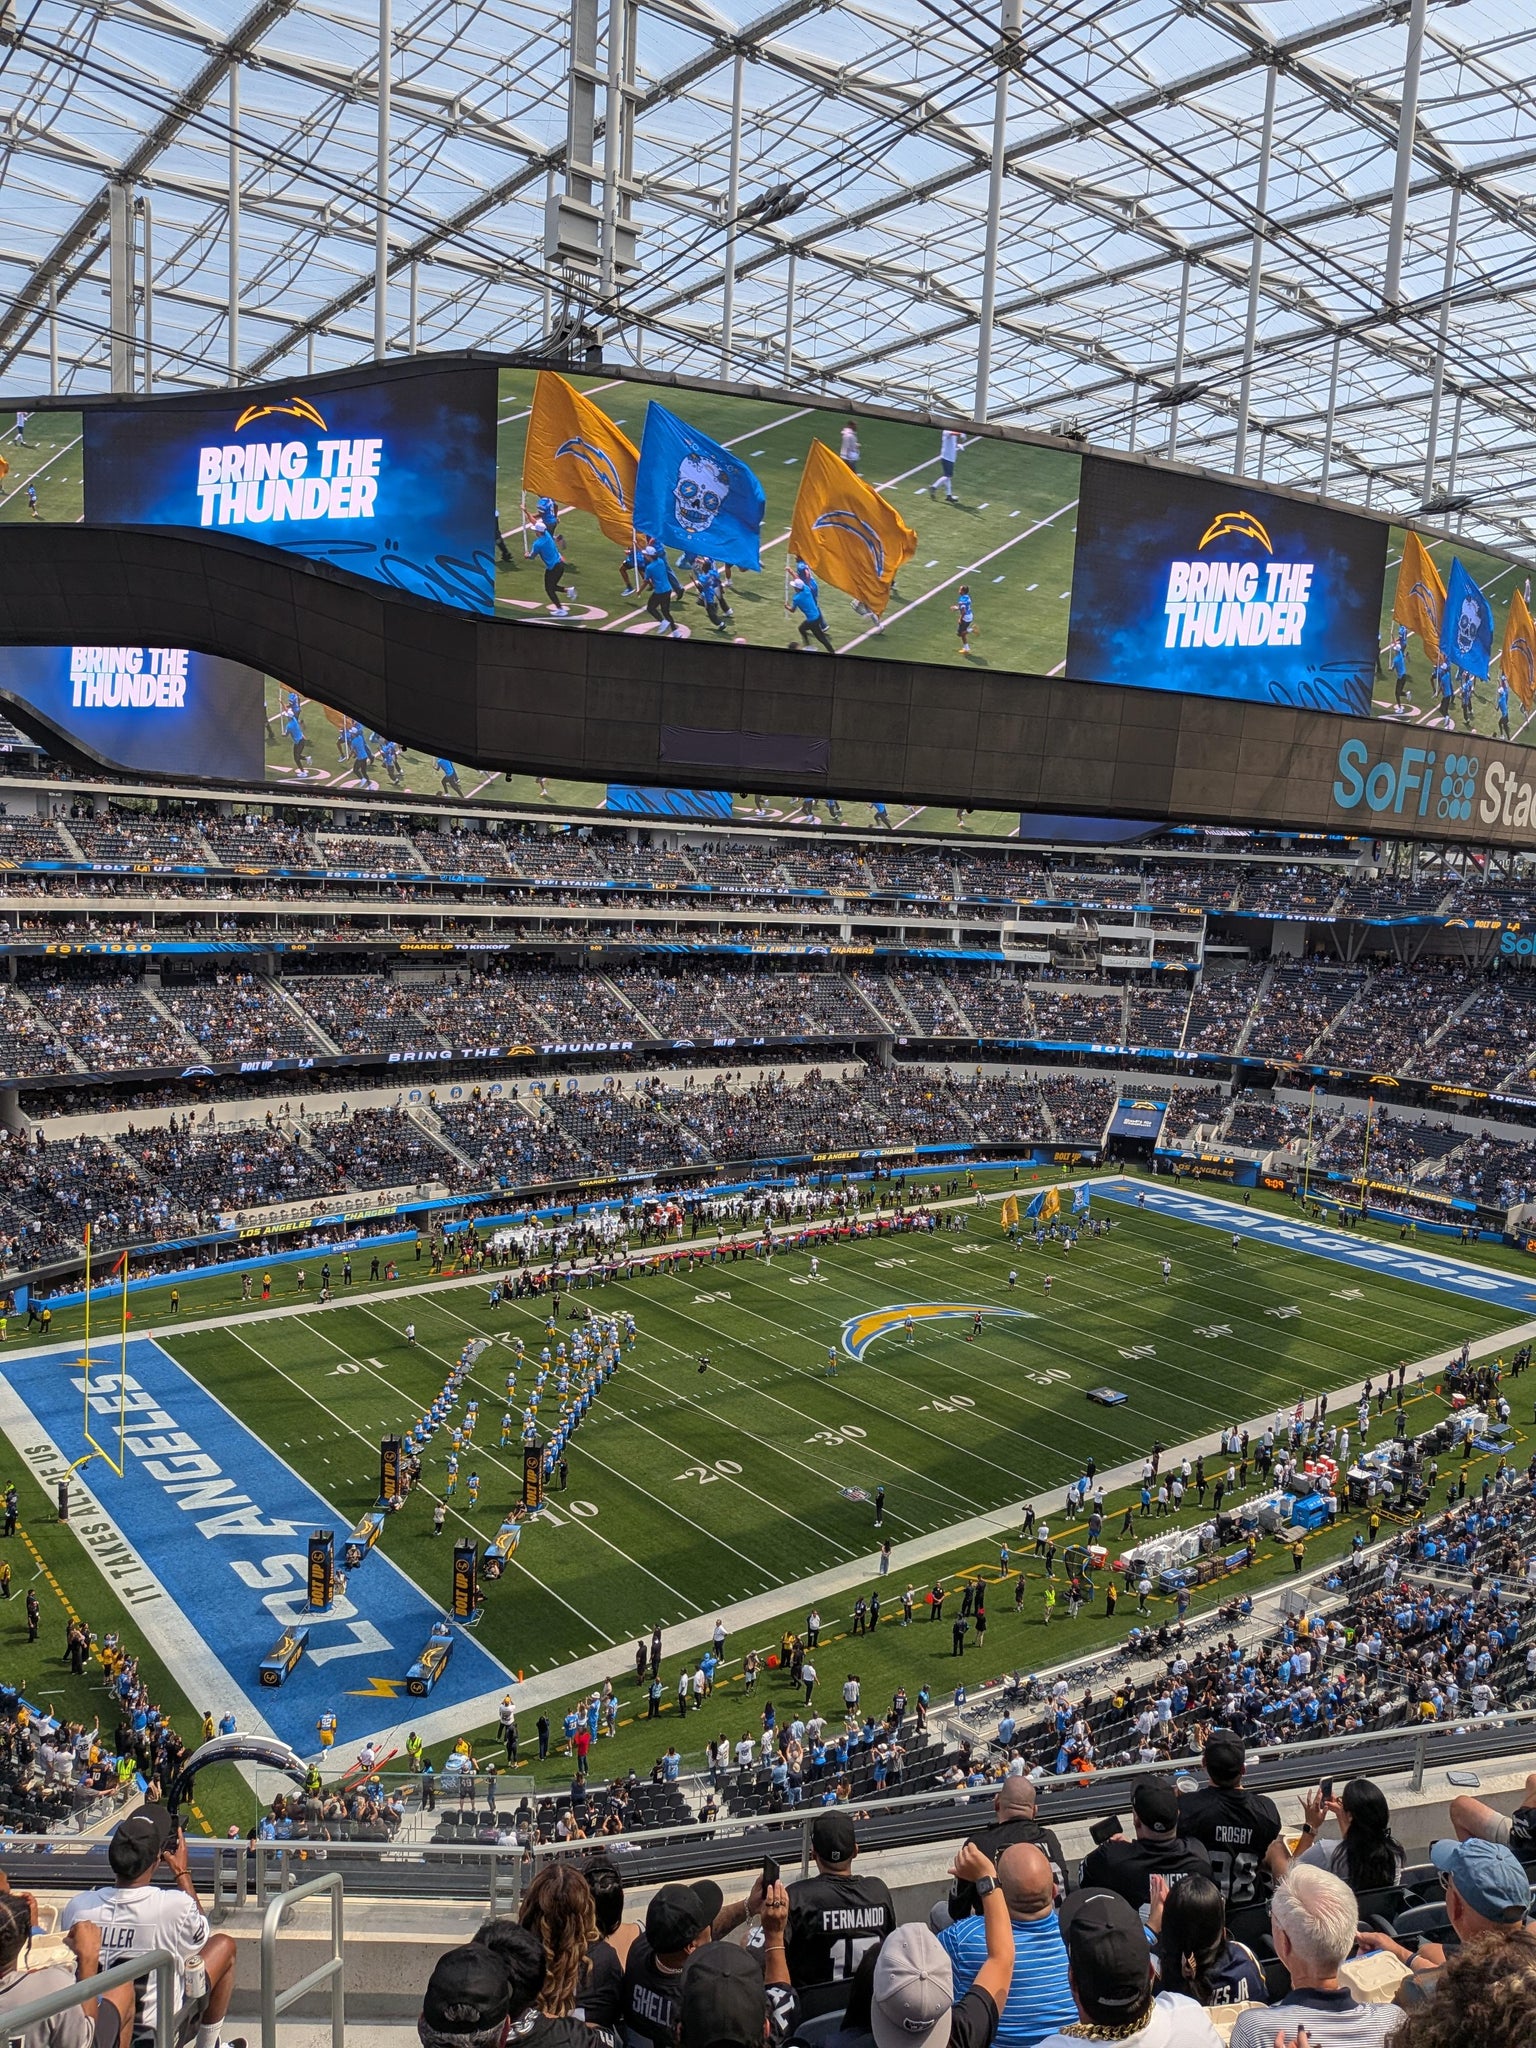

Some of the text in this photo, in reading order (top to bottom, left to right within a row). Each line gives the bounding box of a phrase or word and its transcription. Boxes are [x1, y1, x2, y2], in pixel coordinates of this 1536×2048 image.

[197, 439, 382, 485] BRING THE
[196, 477, 378, 526] THUNDER
[1168, 561, 1314, 602] BRING THE
[1164, 602, 1307, 648] THUNDER
[71, 647, 189, 676] BRING THE
[71, 672, 187, 707] THUNDER
[1333, 738, 1436, 817] SoFi
[719, 886, 775, 894] INGLEWOOD,
[1286, 914, 1336, 922] STADIUM
[1474, 920, 1491, 928] BOLT
[45, 944, 152, 954] EST. 1960
[751, 945, 875, 955] LOS ANGELES CHARGERS
[388, 1041, 634, 1062] BRING THE THUNDER
[713, 1039, 727, 1047] BOLT
[727, 1038, 736, 1046] UP
[1091, 1045, 1140, 1055] BOLT
[241, 1058, 314, 1071] BOLT UP LA
[1431, 1084, 1473, 1096] CHARGE
[827, 1151, 859, 1160] ANGELES
[880, 1147, 916, 1155] CHARGERS
[1054, 1152, 1070, 1161] BOLT
[578, 1178, 603, 1187] CHARGE
[628, 1172, 658, 1181] KICKOFF
[1264, 1178, 1284, 1189] 9:09
[1352, 1177, 1451, 1204] LOS ANGELES CHARGERS
[239, 1207, 397, 1238] LOS ANGELES CHARGERS
[1144, 1194, 1516, 1291] CHARGERS
[698, 1290, 733, 1305] 40
[1263, 1305, 1302, 1320] 20
[1192, 1324, 1234, 1339] 30
[1117, 1345, 1157, 1361] 40
[1024, 1368, 1072, 1386] 50
[931, 1395, 976, 1413] 40
[814, 1425, 867, 1447] 30
[71, 1373, 320, 1539] ANGELES
[384, 1463, 396, 1499] BOLT UP
[684, 1459, 743, 1485] 20
[527, 1469, 538, 1507] BOLT UP
[23, 1444, 162, 1605] IT TAKES ALL OF US
[535, 1500, 599, 1528] 10
[311, 1564, 325, 1607] BOLT UP
[455, 1573, 469, 1617] BOLT UP
[230, 1553, 395, 1667] LOS
[78, 1744, 89, 1752] 32
[92, 1772, 101, 1780] 10
[1215, 1825, 1253, 1845] CROSBY
[822, 1907, 884, 1931] FERNANDO
[100, 1928, 135, 1949] LLER
[1234, 1977, 1250, 2000] JR
